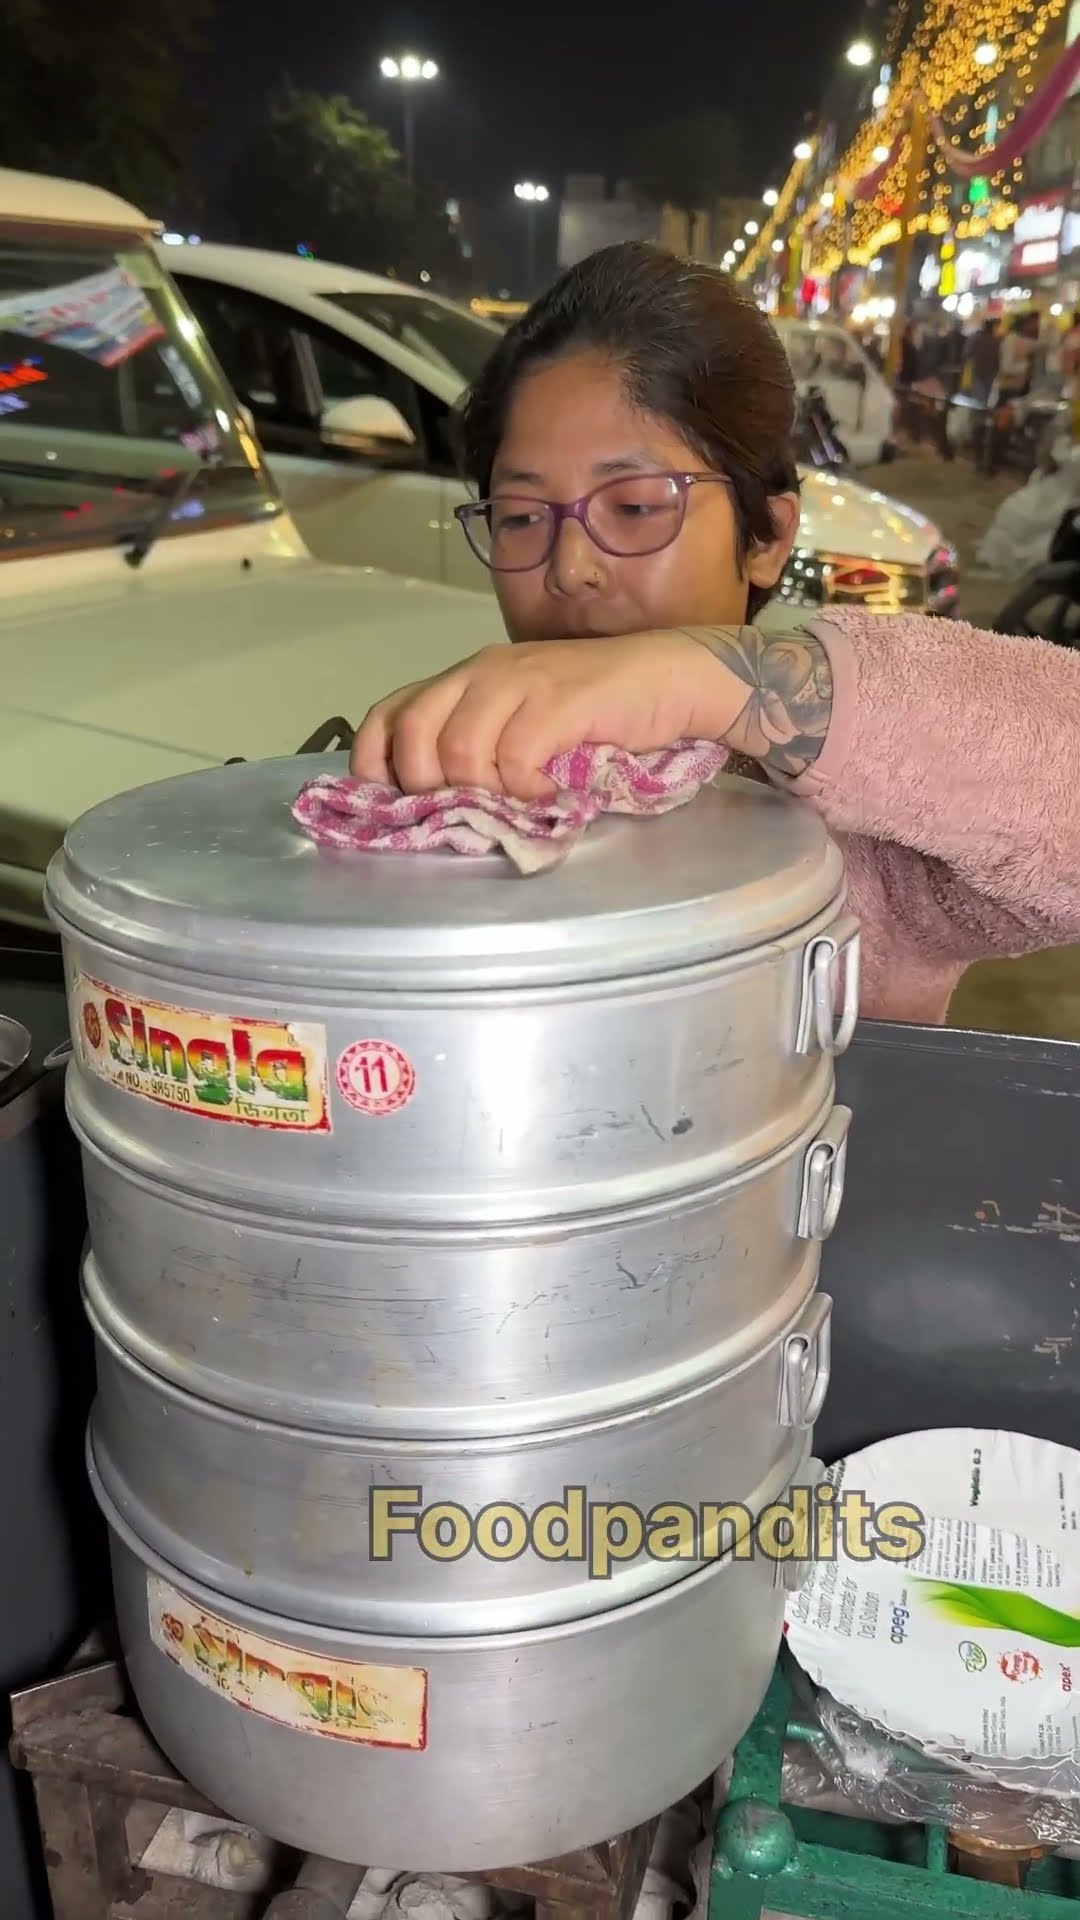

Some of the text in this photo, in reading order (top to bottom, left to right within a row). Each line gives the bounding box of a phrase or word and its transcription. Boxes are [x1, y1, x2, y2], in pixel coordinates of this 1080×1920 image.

[105, 998, 308, 1105] Singla
[150, 1078, 190, 1103] 985750
[355, 1056, 388, 1094] 11
[859, 1591, 880, 1623] Solution
[889, 1607, 910, 1645] apeg
[1060, 1666, 1073, 1692] apex
